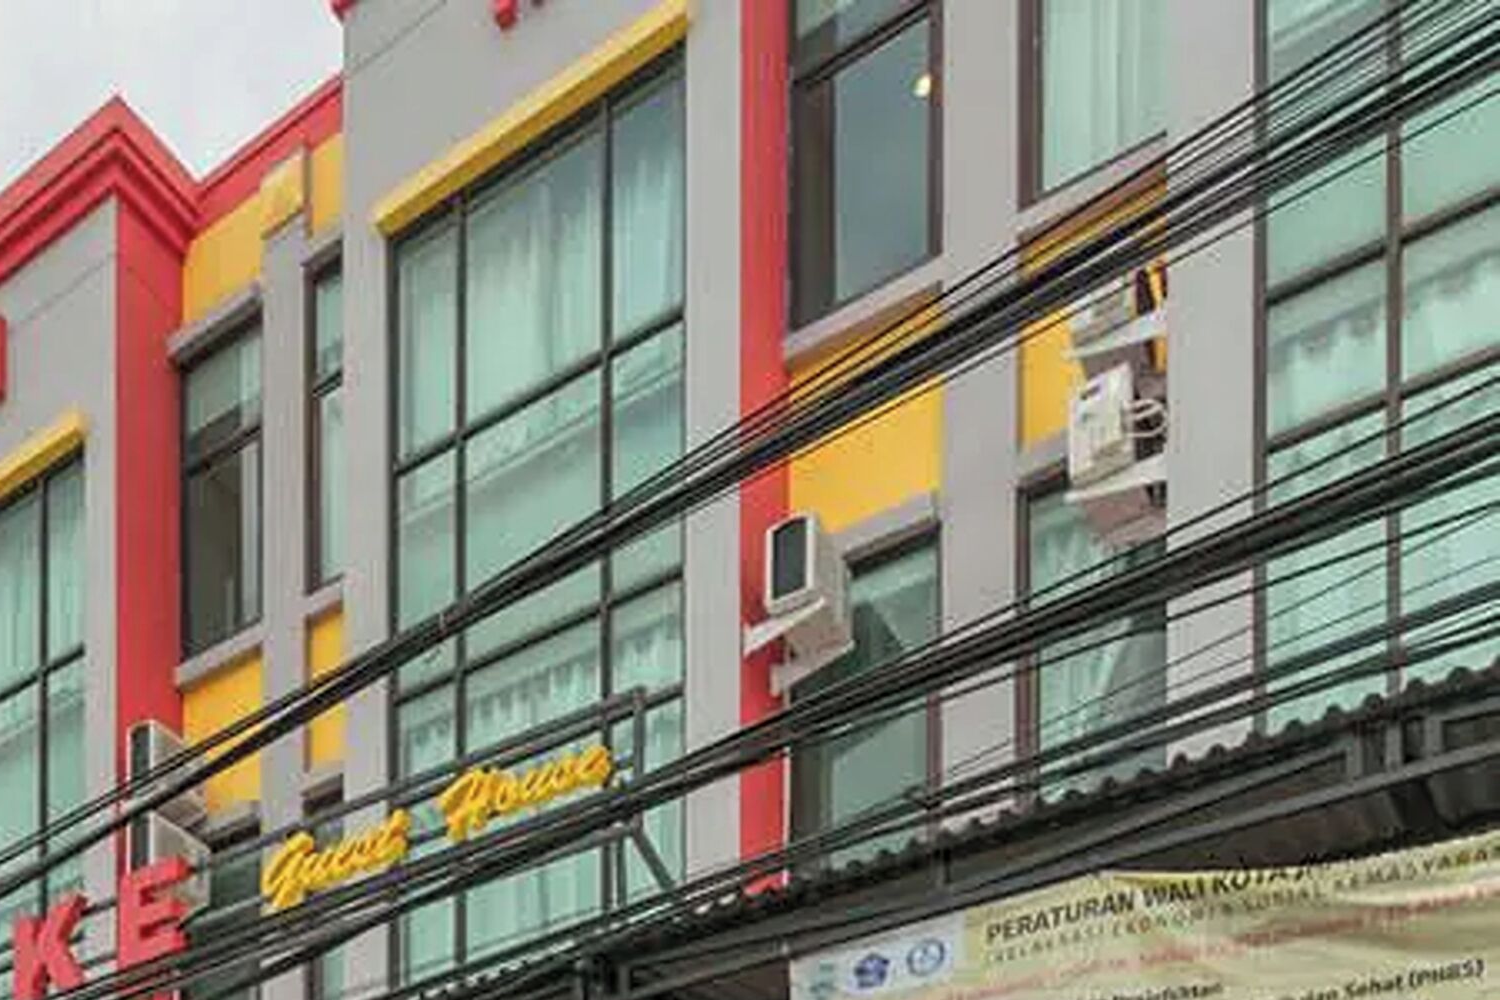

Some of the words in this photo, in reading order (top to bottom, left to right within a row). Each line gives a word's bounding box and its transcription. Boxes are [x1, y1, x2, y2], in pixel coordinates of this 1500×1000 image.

[258, 808, 411, 915] Guest
[437, 743, 619, 843] House
[987, 888, 1135, 944] PERATURAN
[1143, 876, 1206, 908] WALI
[1345, 975, 1403, 998] Sehat
